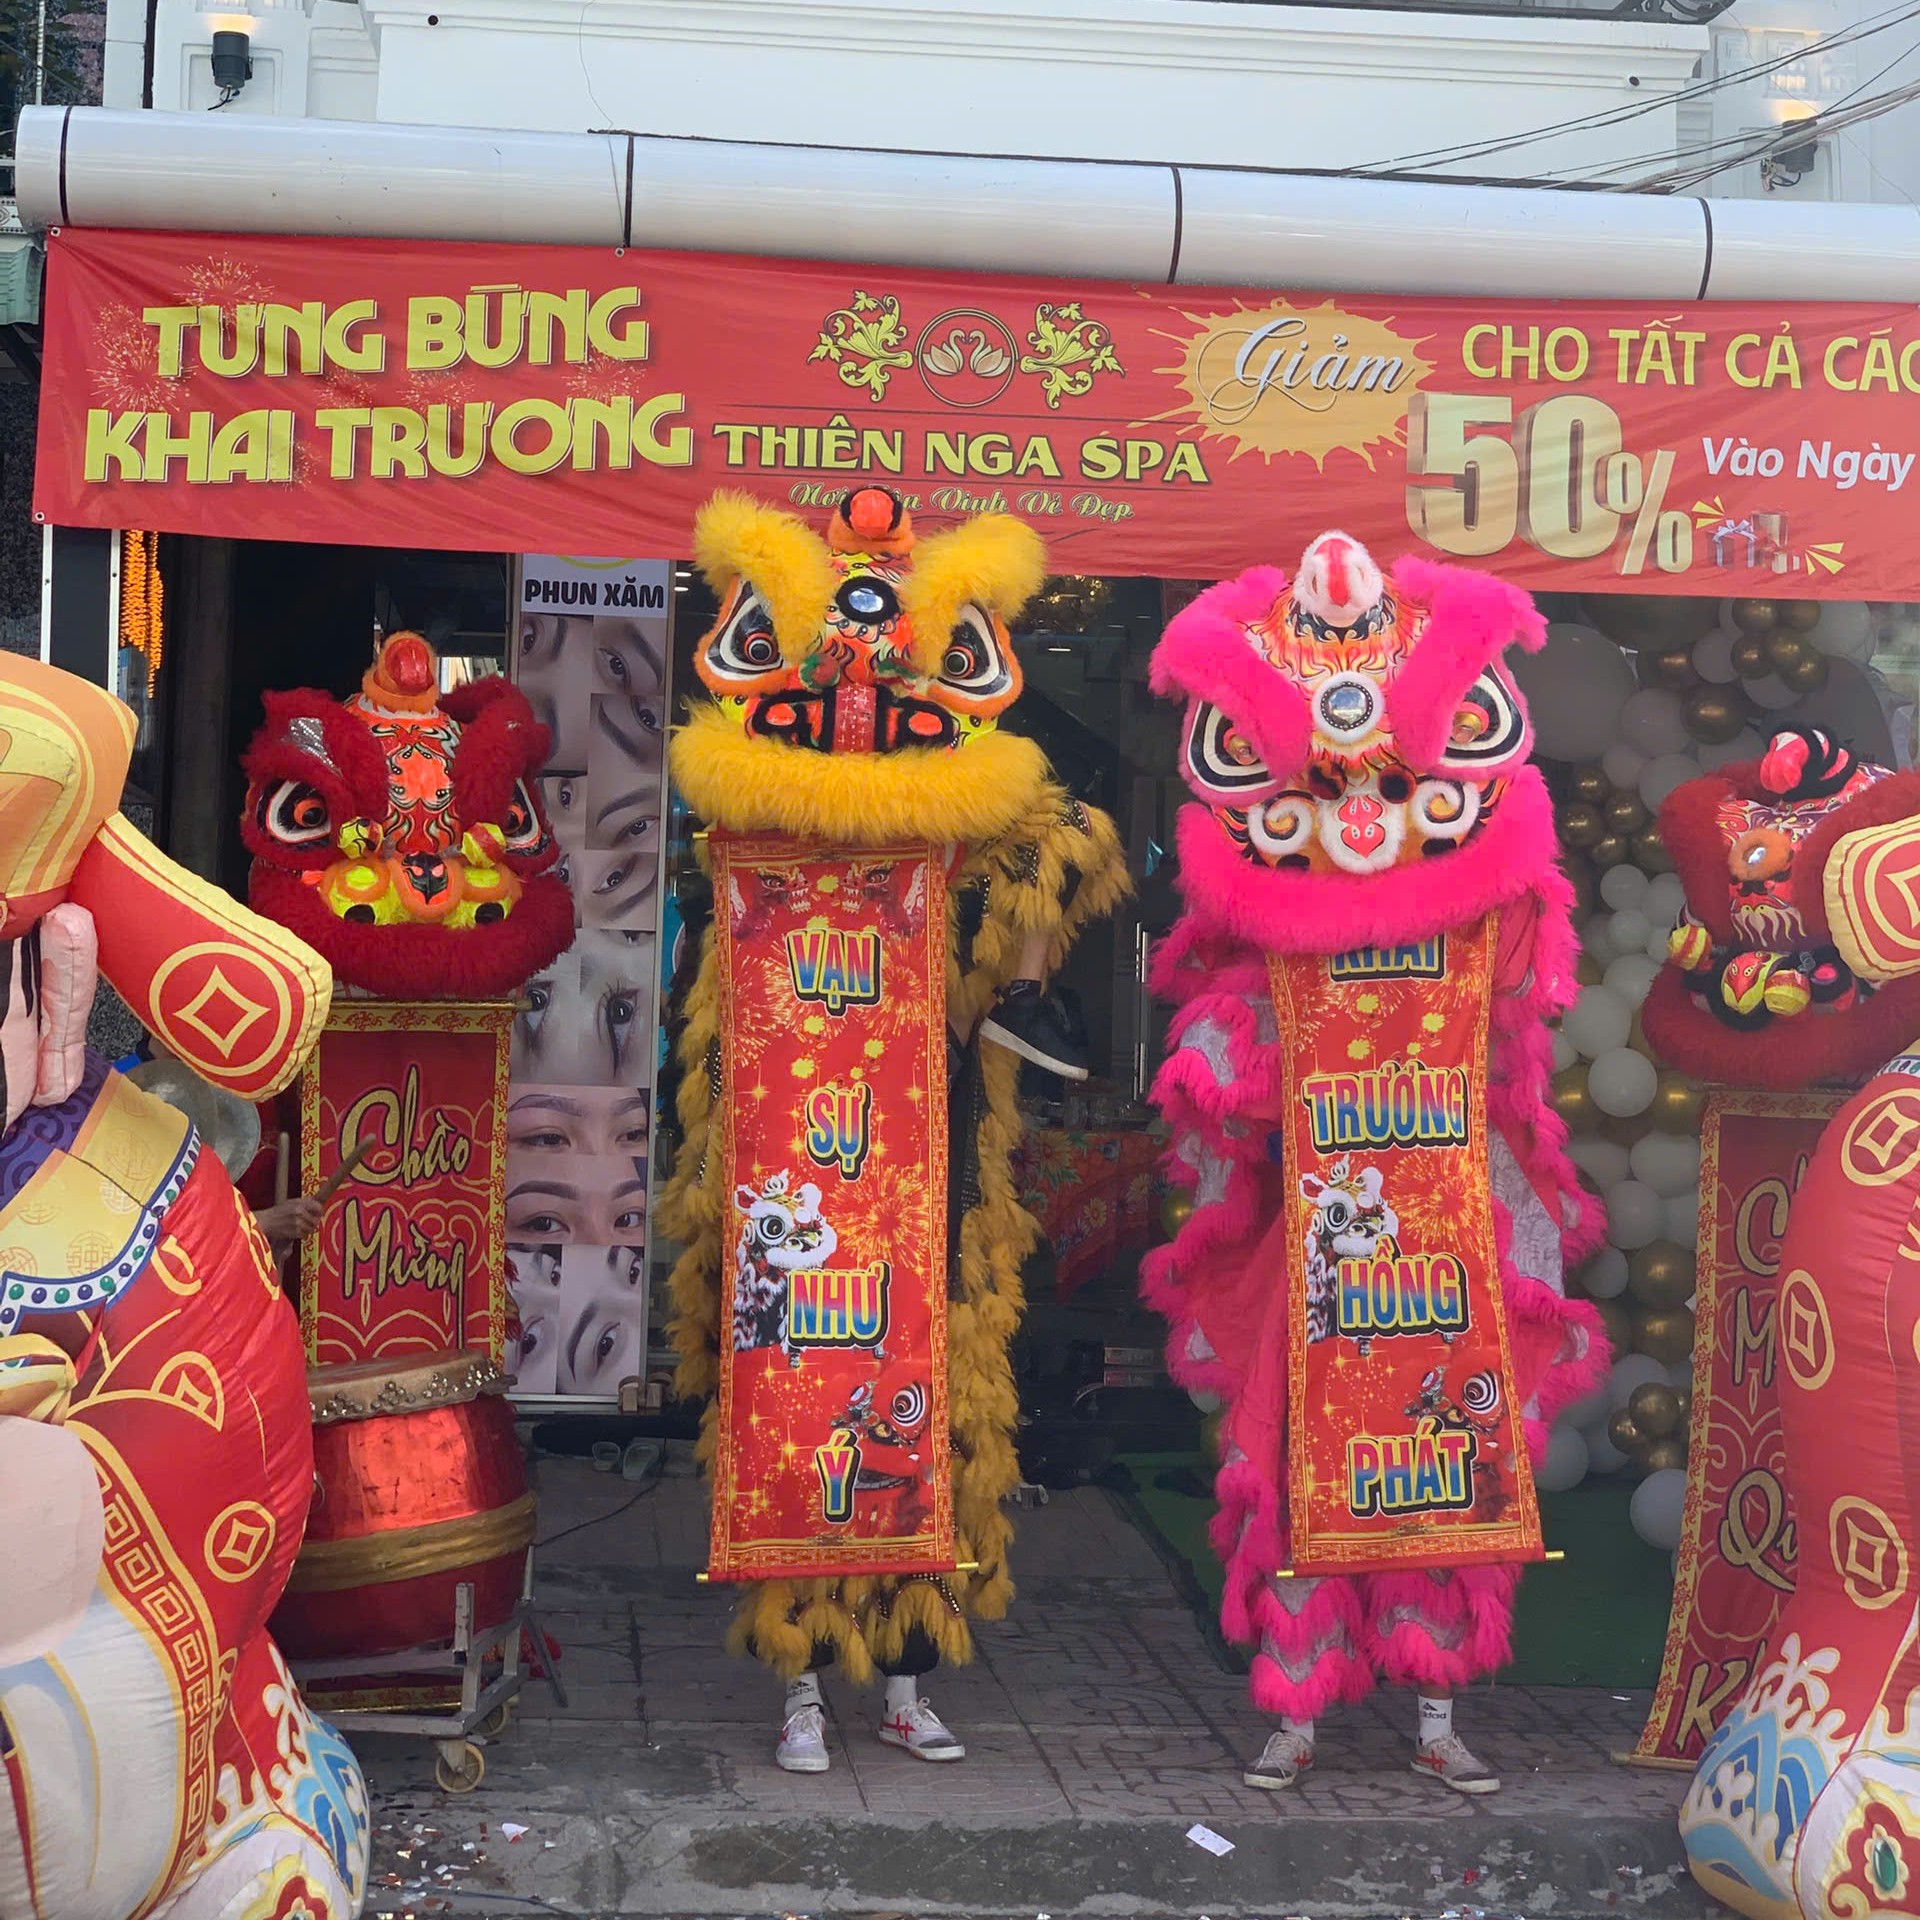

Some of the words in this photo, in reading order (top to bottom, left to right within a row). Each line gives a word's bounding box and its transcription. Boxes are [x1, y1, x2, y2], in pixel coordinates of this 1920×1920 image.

[142, 299, 385, 378] TƯNG
[1196, 317, 1415, 425] Giảm
[1462, 323, 1589, 382] CHO
[1608, 314, 1707, 386] TẤT
[1724, 320, 1802, 390] CẢ
[84, 408, 294, 483] KHAI
[315, 393, 693, 479] TRƯƠNG
[712, 414, 904, 474] THIÊN
[924, 431, 1062, 478] NGA
[1080, 436, 1210, 484] SPA
[1702, 437, 1784, 478] Vào
[1797, 440, 1916, 491] Ngày
[930, 487, 1009, 513] Vinh
[1405, 392, 1693, 577] 50%
[524, 579, 597, 606] PHUN
[603, 575, 664, 608] XĂM
[786, 928, 882, 1017] VẠN
[340, 1062, 471, 1187] Chào
[805, 1082, 873, 1181] SỰ
[787, 1259, 891, 1349] NHƯ
[1337, 1233, 1472, 1338] HỒNG
[814, 1428, 862, 1524] Ý
[1347, 1415, 1478, 1519] PHÁT
